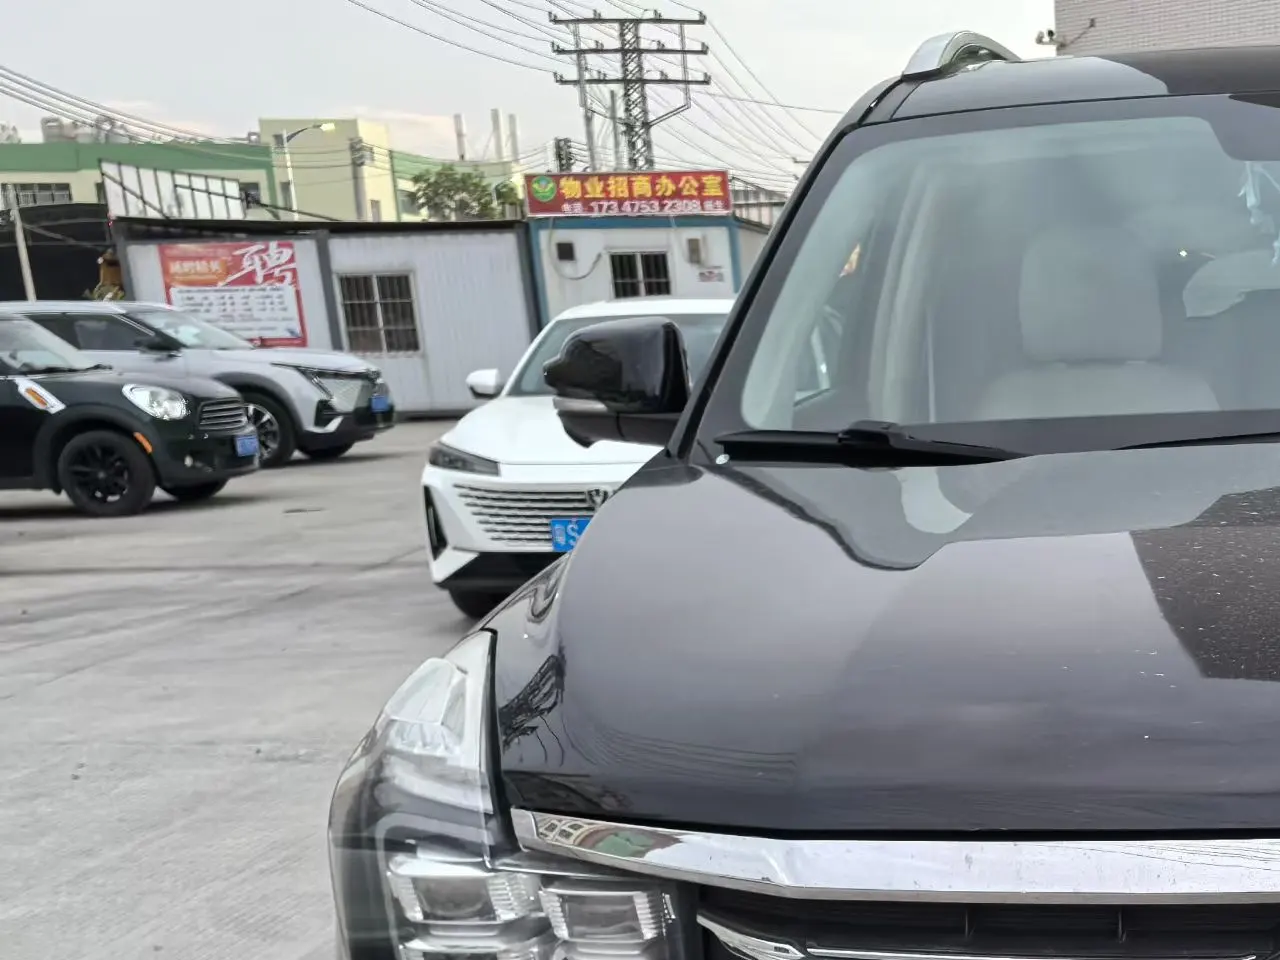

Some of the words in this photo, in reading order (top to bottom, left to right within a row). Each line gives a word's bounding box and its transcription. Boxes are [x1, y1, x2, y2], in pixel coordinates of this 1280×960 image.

[559, 175, 724, 198] 物业招商办公室
[217, 240, 297, 287] 聘
